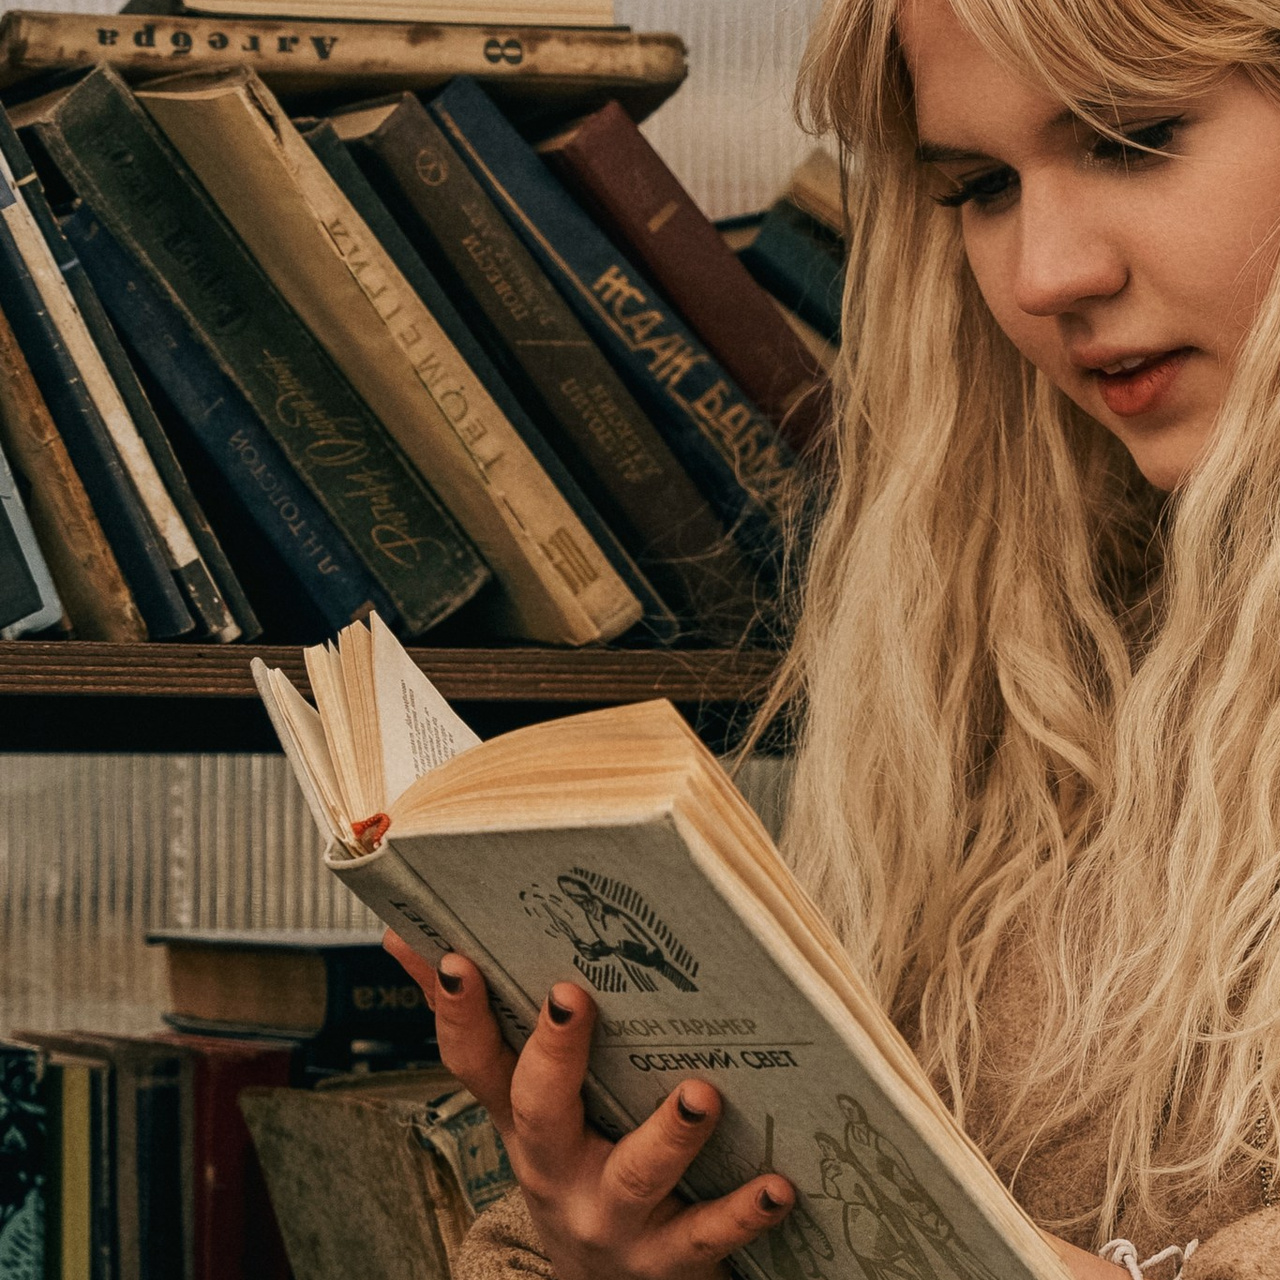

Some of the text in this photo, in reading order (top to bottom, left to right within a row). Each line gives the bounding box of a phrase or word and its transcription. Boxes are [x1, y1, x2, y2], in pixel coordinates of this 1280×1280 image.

[96, 27, 524, 66] 8 Алгебра
[668, 1018, 758, 1037] ГАРДНЕР
[629, 1048, 800, 1071] ОСЕННИЙ СВЕТ
